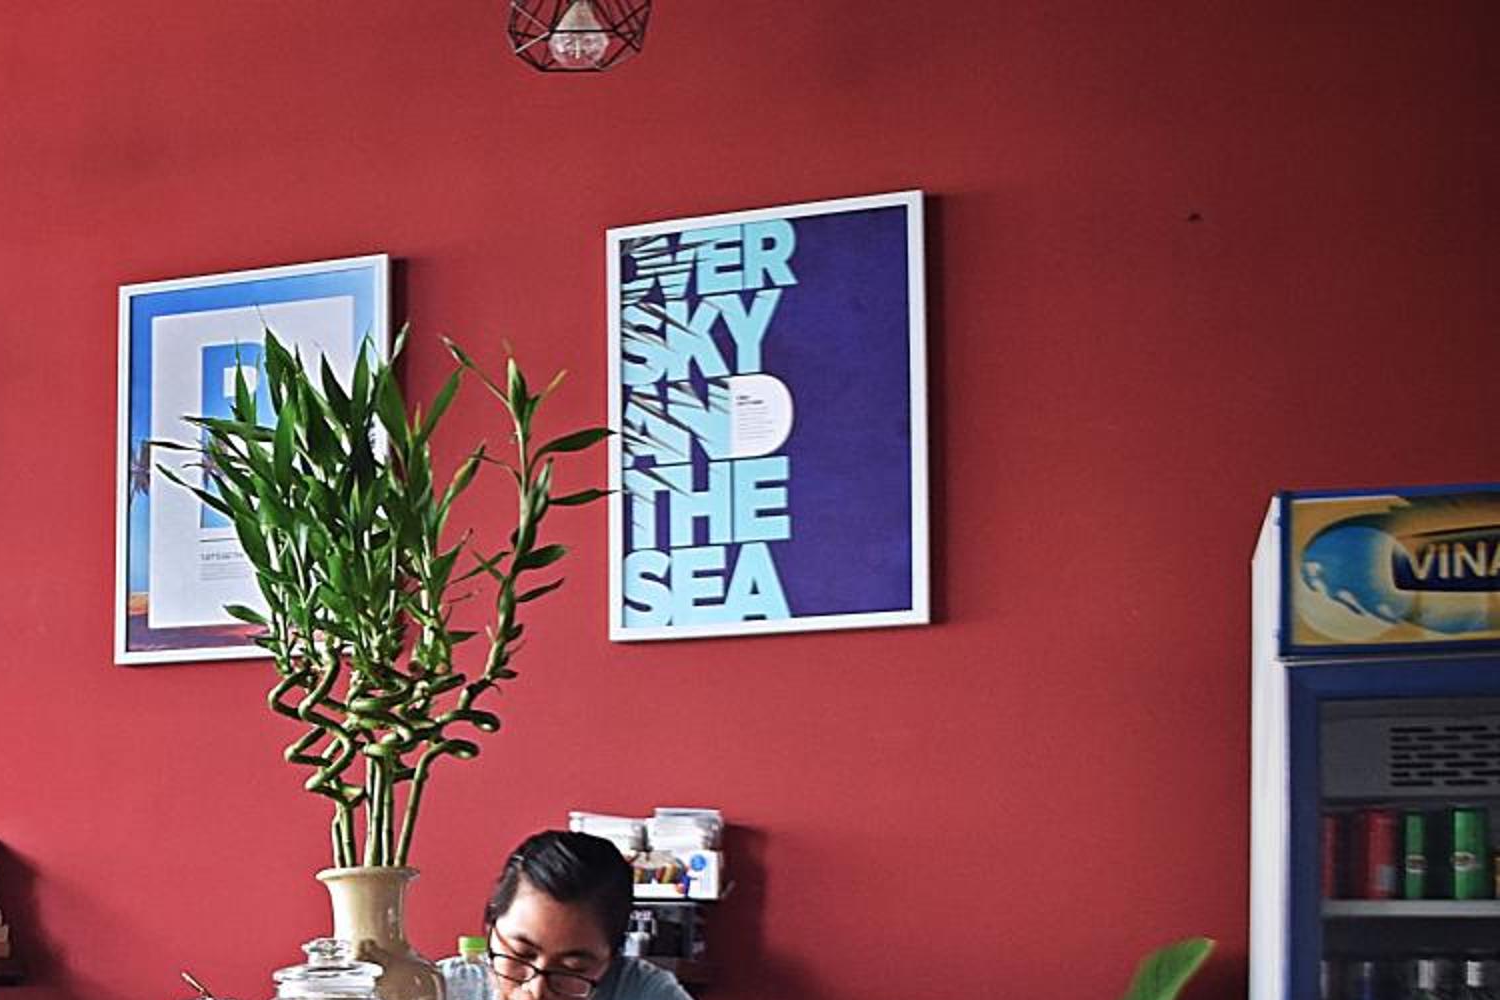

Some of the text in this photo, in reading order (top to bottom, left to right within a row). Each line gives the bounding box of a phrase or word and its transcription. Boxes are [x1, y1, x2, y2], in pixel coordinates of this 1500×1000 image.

[622, 288, 783, 385] SKY
[622, 373, 793, 467] AND
[623, 456, 791, 550] THE
[623, 541, 792, 628] SEA
